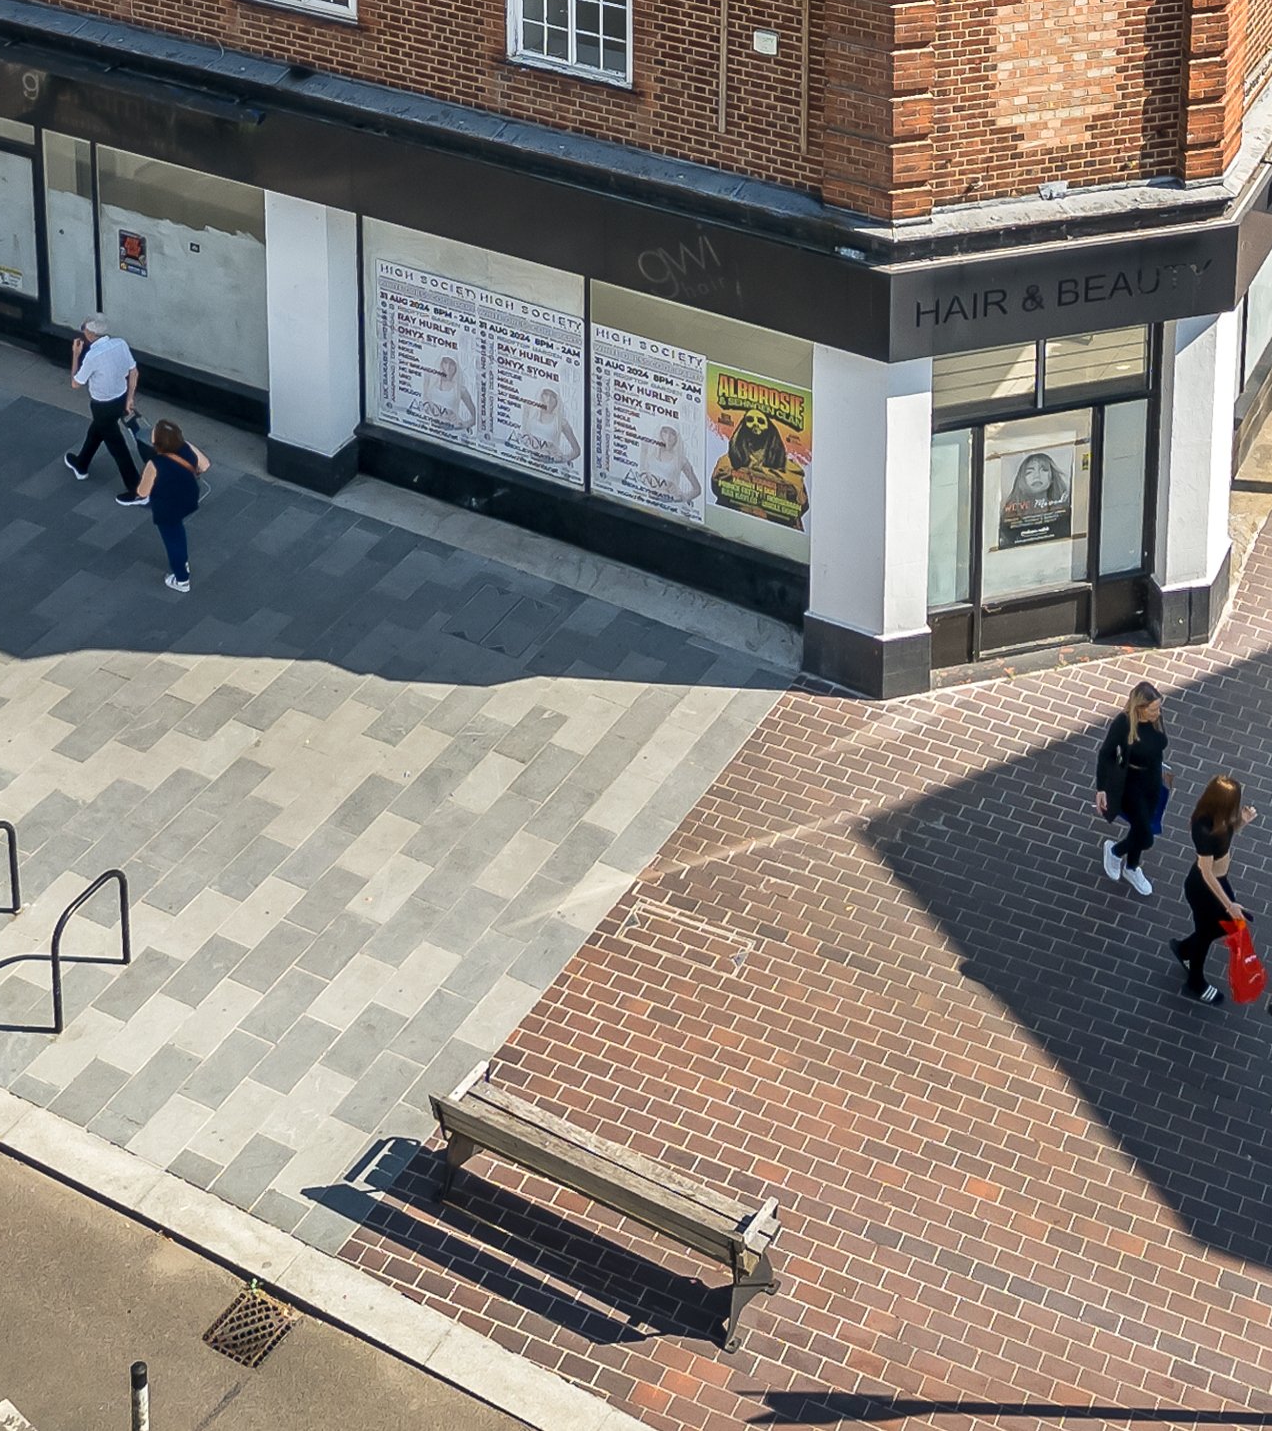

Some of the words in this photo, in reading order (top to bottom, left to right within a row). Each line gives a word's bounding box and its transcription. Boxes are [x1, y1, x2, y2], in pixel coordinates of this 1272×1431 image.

[380, 263, 414, 281] HIGH
[915, 288, 1008, 328] HAIR
[1021, 284, 1046, 312] &
[1057, 258, 1214, 307] BEAUTY
[390, 295, 408, 306] AUG
[409, 300, 430, 312] 2024
[433, 307, 452, 319] 8PM
[480, 293, 514, 310] HIGH
[521, 305, 582, 330] SOCIETY
[398, 312, 416, 325] RAY
[419, 319, 457, 336] HURLEY
[398, 326, 424, 340] ONYX
[427, 335, 458, 350] STONE
[489, 325, 508, 335] AUG
[510, 331, 531, 342] 2024
[535, 338, 554, 350] 8PM
[562, 346, 581, 358] 2AM
[596, 328, 631, 346] HIGH
[639, 340, 703, 367] SOCIETY
[497, 343, 517, 355] RAY
[519, 349, 558, 368] HURLEY
[497, 356, 525, 370] ONYX
[527, 366, 559, 382] STONE
[605, 360, 625, 371] AUG
[627, 366, 649, 379] 2024
[653, 374, 673, 386] 8PM
[681, 383, 702, 396] 2AM
[614, 379, 635, 391] RAY
[637, 386, 678, 405] HURLEY
[718, 373, 805, 420] ALBOROSIE
[614, 393, 642, 408] ONYX
[645, 402, 679, 419] STONE
